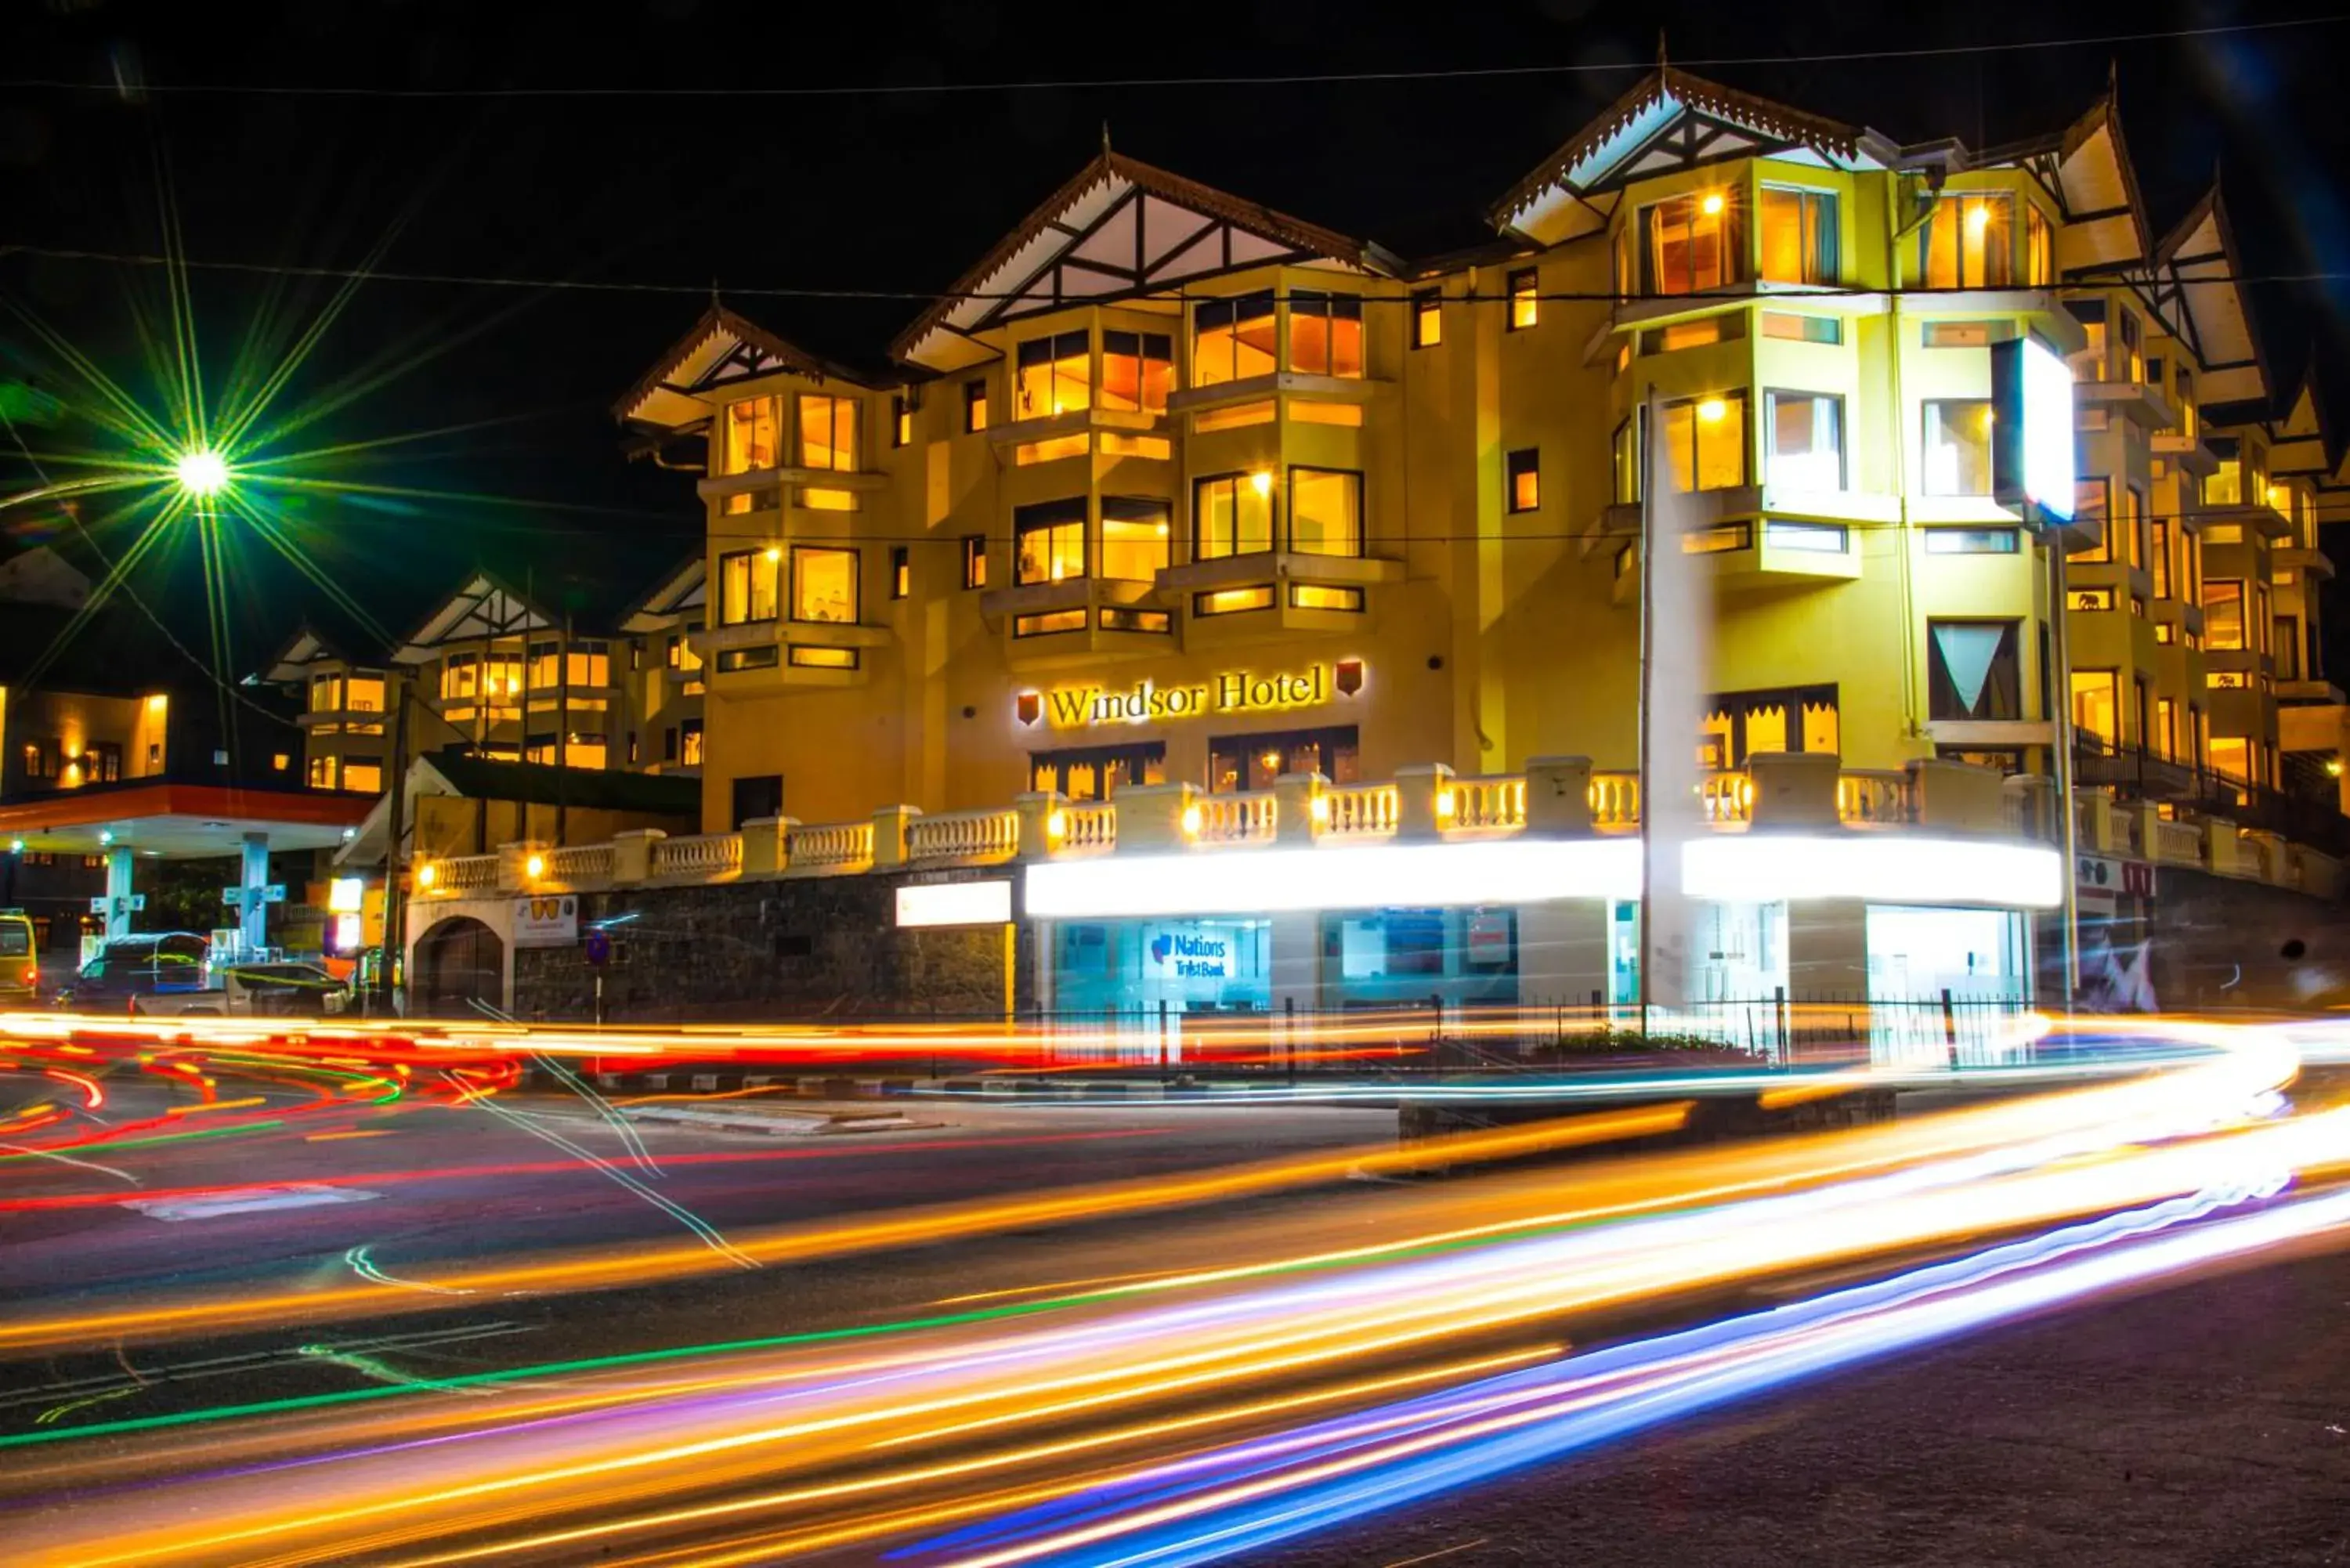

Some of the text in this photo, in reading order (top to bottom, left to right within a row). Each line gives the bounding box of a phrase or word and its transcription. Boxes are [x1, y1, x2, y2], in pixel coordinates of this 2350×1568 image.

[1052, 665, 1321, 724] Windsor Hotel
[1175, 934, 1225, 958] Nations
